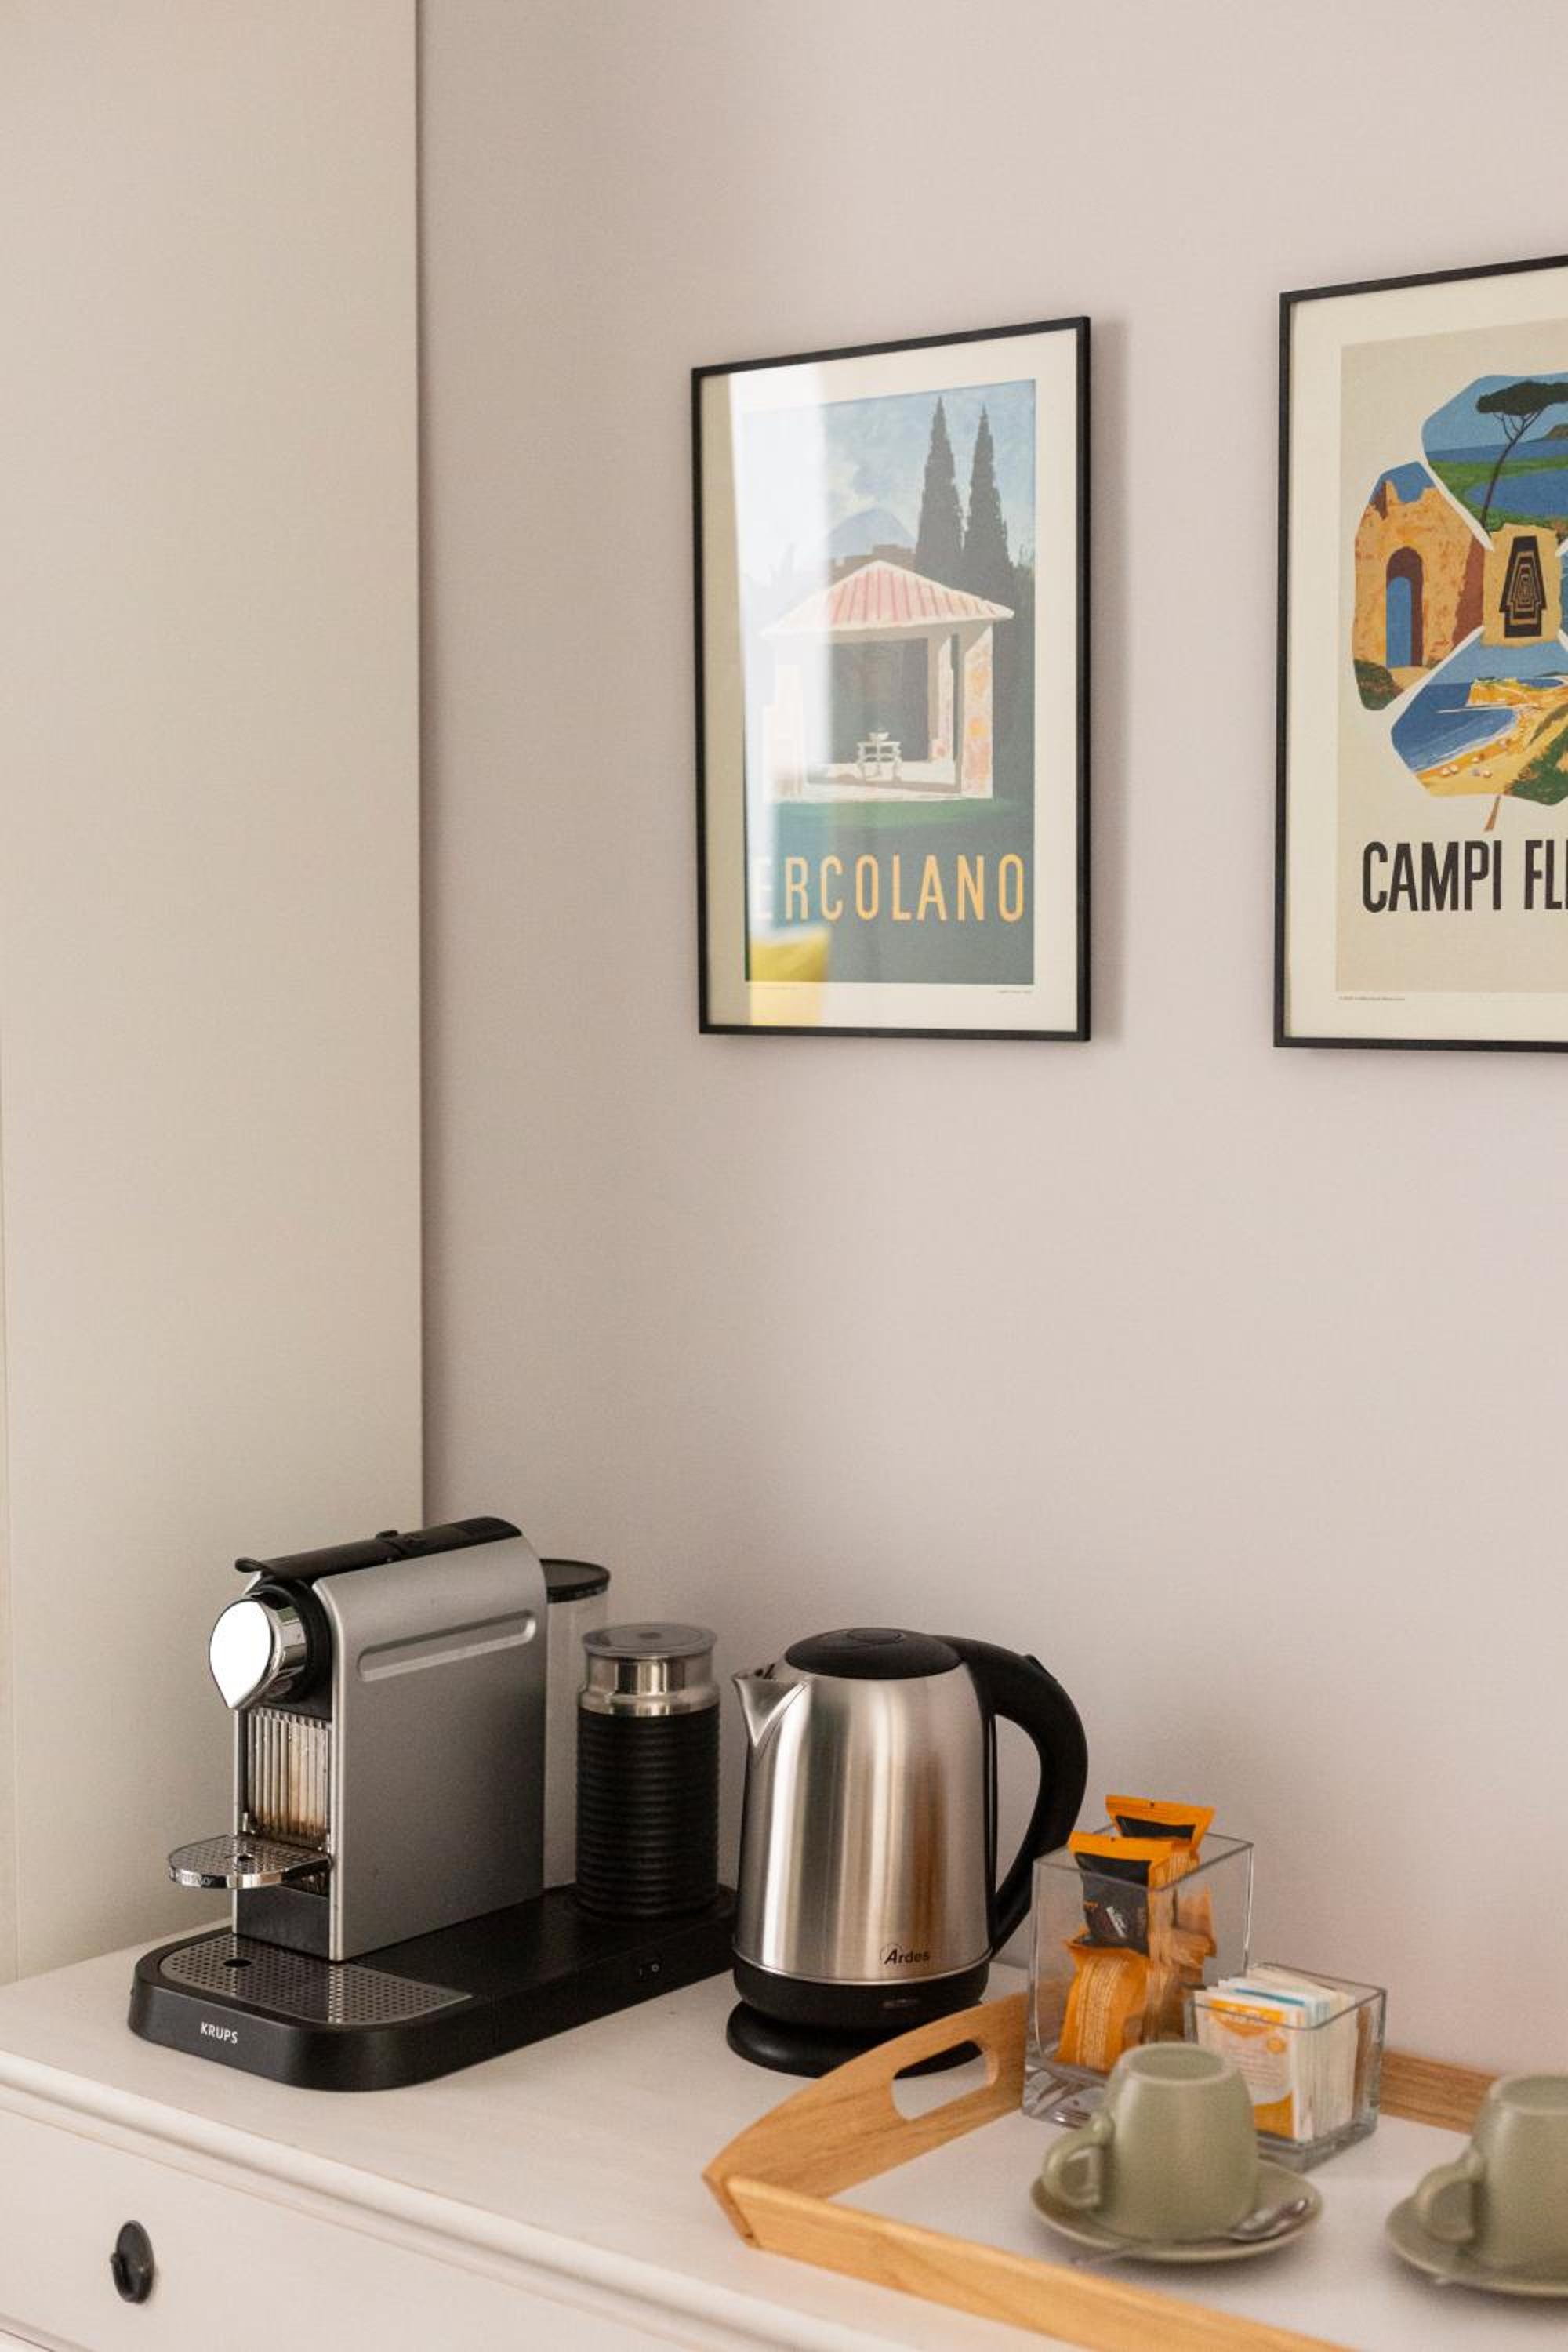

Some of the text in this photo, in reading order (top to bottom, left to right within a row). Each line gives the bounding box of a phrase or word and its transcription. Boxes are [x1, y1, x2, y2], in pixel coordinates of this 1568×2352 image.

[753, 852, 1024, 922] ERCOLANO
[1363, 839, 1568, 913] CAMPI FL
[884, 1948, 930, 1965] Ardes
[200, 2021, 238, 2045] KRUPS
